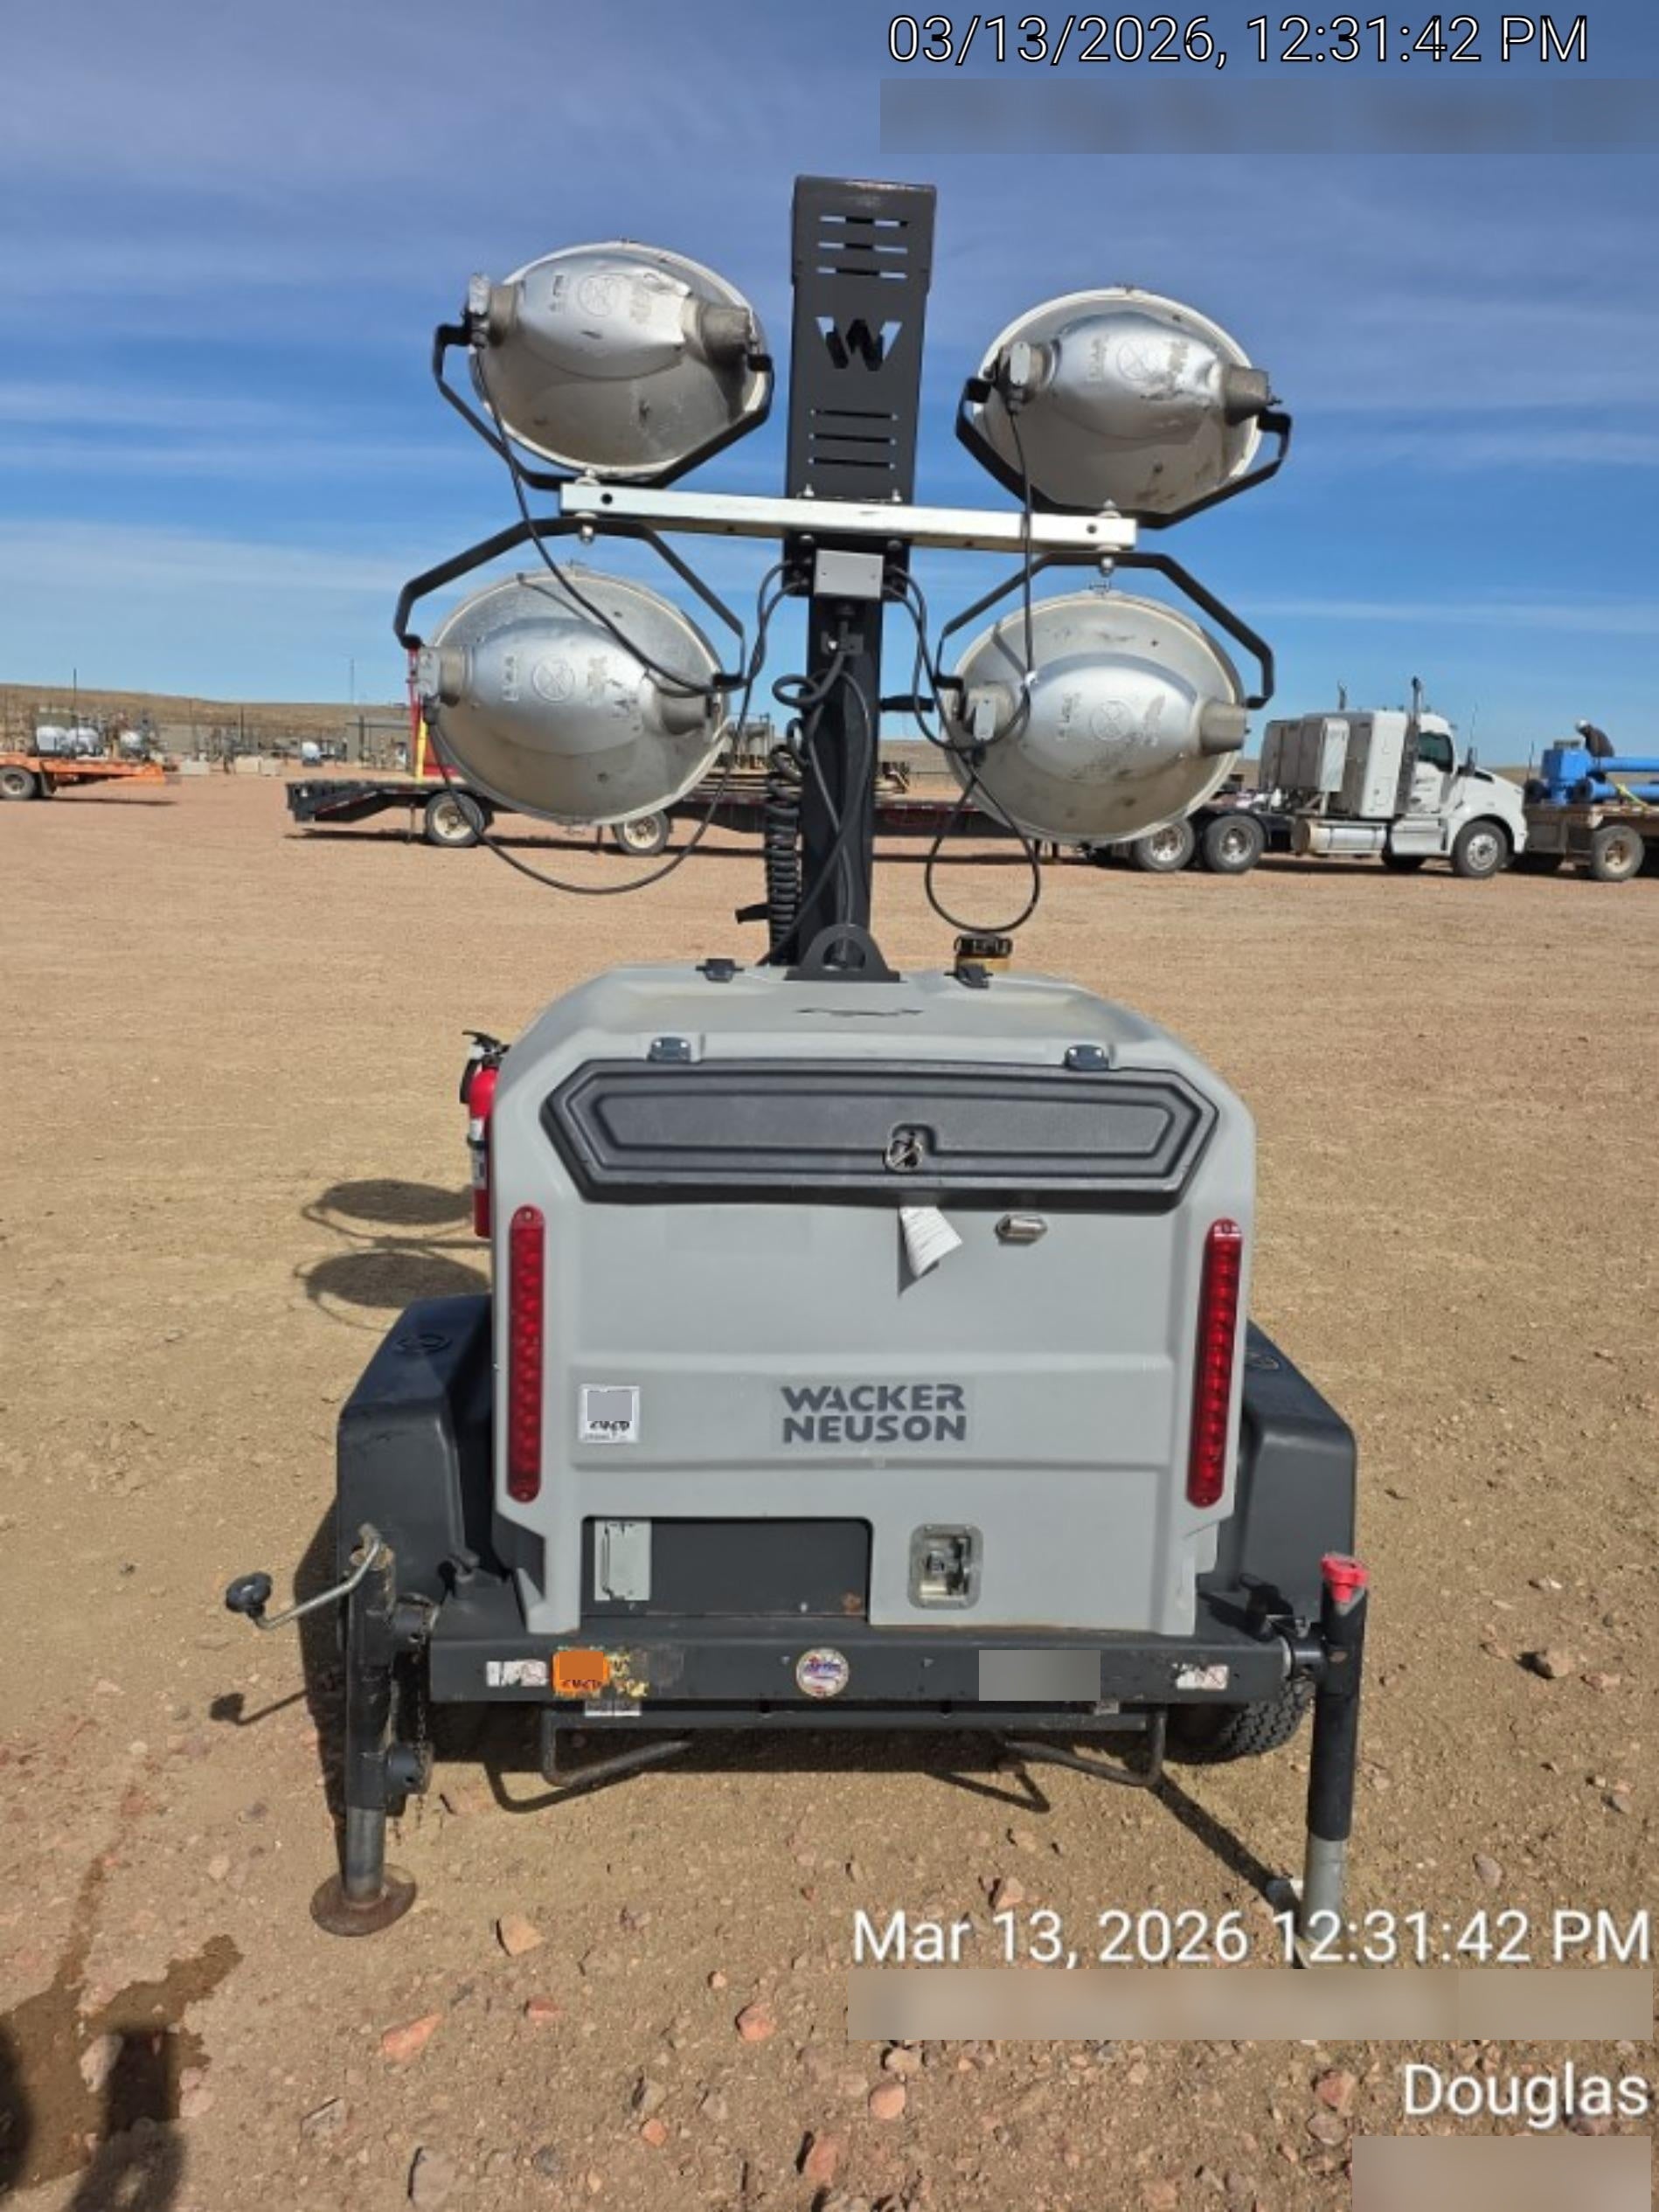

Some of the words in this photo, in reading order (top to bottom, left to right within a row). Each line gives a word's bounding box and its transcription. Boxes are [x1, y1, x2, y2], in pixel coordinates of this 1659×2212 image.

[815, 316, 903, 371] W
[781, 1383, 965, 1411] WACKER
[783, 1415, 967, 1443] NEUSON
